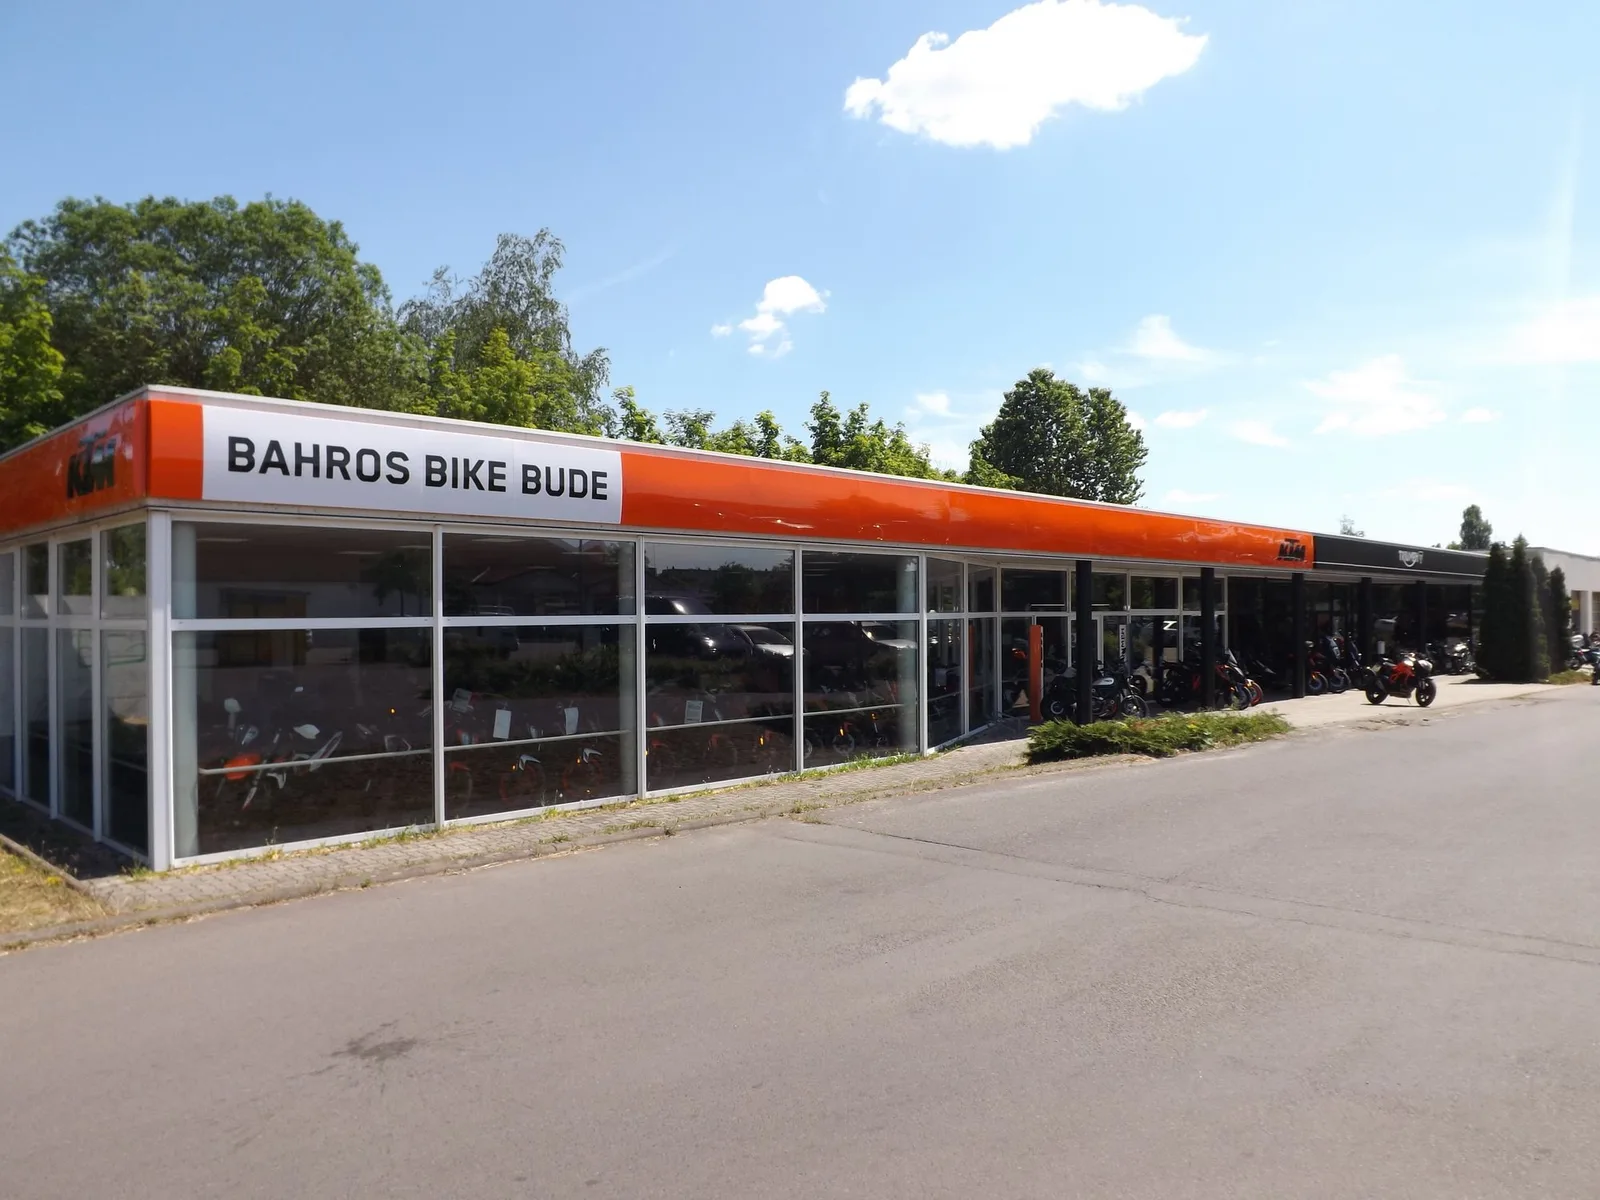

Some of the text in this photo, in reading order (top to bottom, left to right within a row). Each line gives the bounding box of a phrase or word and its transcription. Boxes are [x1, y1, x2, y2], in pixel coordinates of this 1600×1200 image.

[228, 436, 608, 501] BAHROS BIKE BUDE
[1277, 538, 1306, 561] KTM
